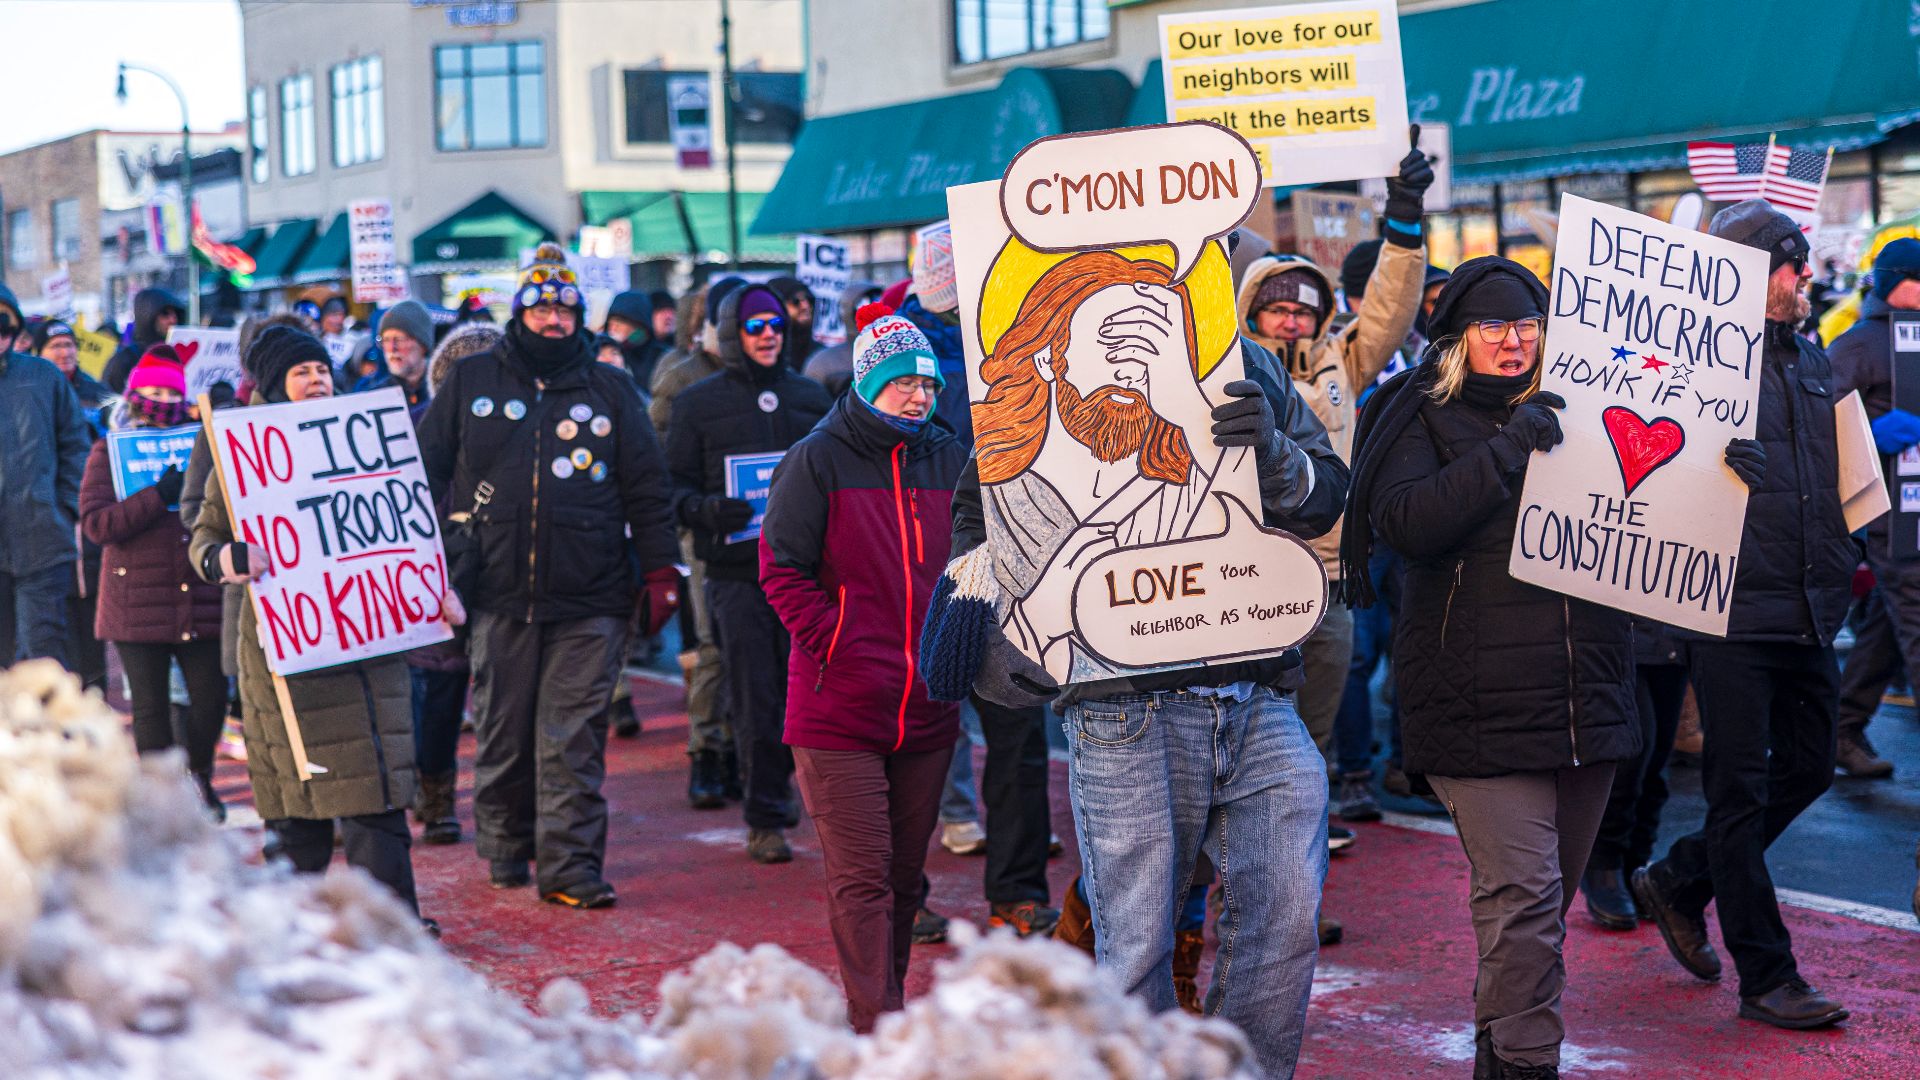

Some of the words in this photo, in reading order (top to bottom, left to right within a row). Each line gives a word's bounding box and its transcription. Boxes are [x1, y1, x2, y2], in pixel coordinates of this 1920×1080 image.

[1178, 31, 1222, 51] Our
[1234, 28, 1283, 46] love
[1293, 23, 1326, 42] for
[1334, 20, 1373, 39] our
[1184, 66, 1302, 92] neighbors
[1310, 62, 1349, 82] will
[1459, 66, 1585, 126] Plaza
[1187, 111, 1238, 129] lt
[1250, 109, 1286, 129] the
[1296, 105, 1370, 127] hearts
[1025, 168, 1145, 216] C'MON
[1159, 159, 1239, 205] DON
[803, 242, 845, 271] ICE
[1589, 217, 1741, 306] DEFEND
[1555, 266, 1763, 380] DEMOCRACY
[1549, 351, 1643, 399] HONK
[1651, 380, 1686, 406] IF
[1695, 390, 1749, 427] YOU
[225, 421, 294, 497] NO
[298, 406, 418, 480] ICE
[241, 514, 300, 583] NO
[296, 478, 436, 557] TROOPS
[1588, 493, 1650, 527] THE
[1104, 562, 1206, 608] LOVE
[1220, 564, 1260, 580] YOUR
[1520, 504, 1736, 614] CONSTITUTION
[260, 587, 323, 661] NO
[323, 553, 449, 650] KINGS!
[1130, 613, 1211, 637] NEIGHBOR
[1220, 608, 1240, 626] AS
[1248, 600, 1315, 621] YOURSELF
